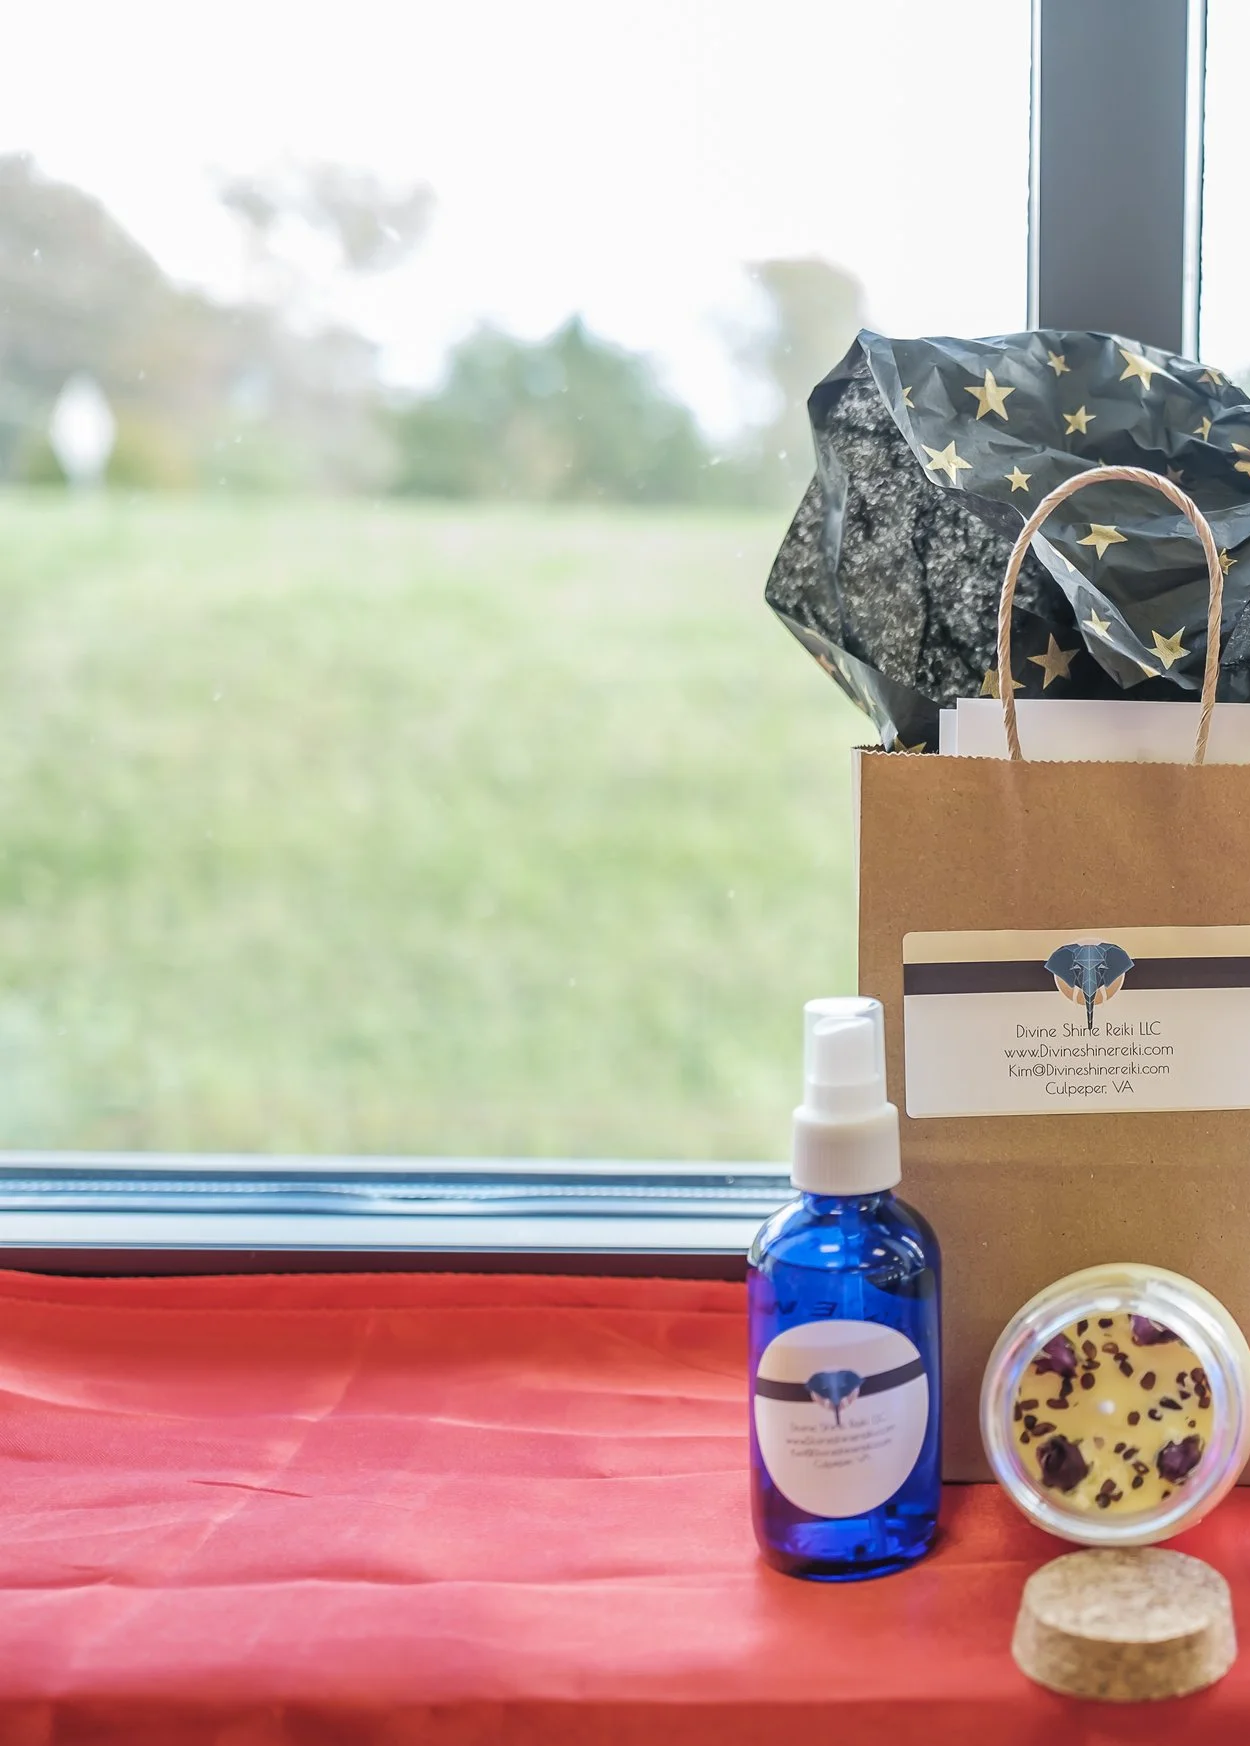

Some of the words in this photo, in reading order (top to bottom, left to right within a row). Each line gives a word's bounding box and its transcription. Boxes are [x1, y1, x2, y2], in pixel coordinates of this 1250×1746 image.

[1016, 1024, 1057, 1038] Divine
[1063, 1023, 1100, 1037] Shine
[1106, 1022, 1134, 1036] Reiki
[1139, 1021, 1161, 1036] LLC
[1004, 1042, 1174, 1058] www.Divineshinereiki.com
[1009, 1062, 1170, 1077] Kim@Divineshinereiki.com
[1112, 1080, 1134, 1094] VA
